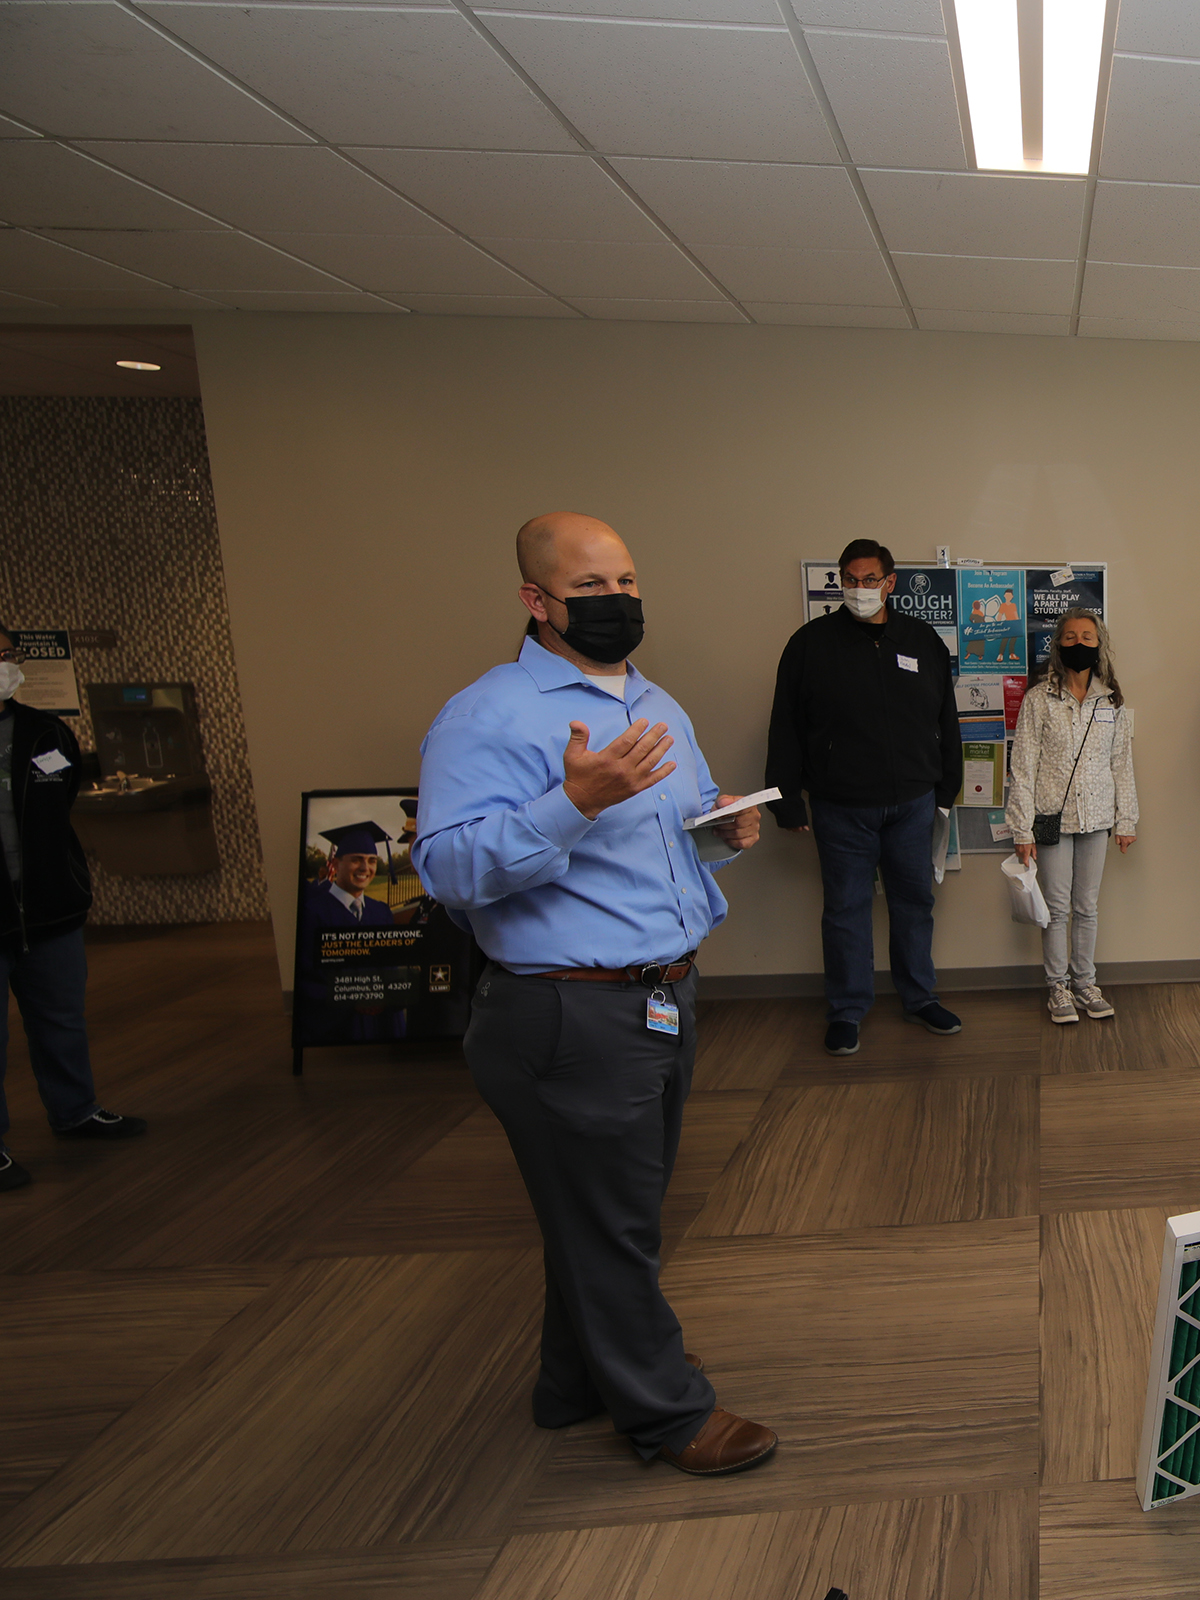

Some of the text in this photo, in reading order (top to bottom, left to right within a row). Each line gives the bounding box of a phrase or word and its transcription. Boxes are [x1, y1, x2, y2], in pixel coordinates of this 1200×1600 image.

[889, 595, 953, 610] TOUGH
[321, 929, 423, 941] IT'S NOT FOR EVERYONE.
[321, 938, 416, 949] JUST THE LEADERS OF
[321, 948, 371, 957] TOMORROW.
[334, 975, 382, 984] 3481 High St.
[334, 984, 371, 993] Columbus,
[387, 983, 412, 991] 43207
[333, 992, 384, 1002] 614-497-3790
